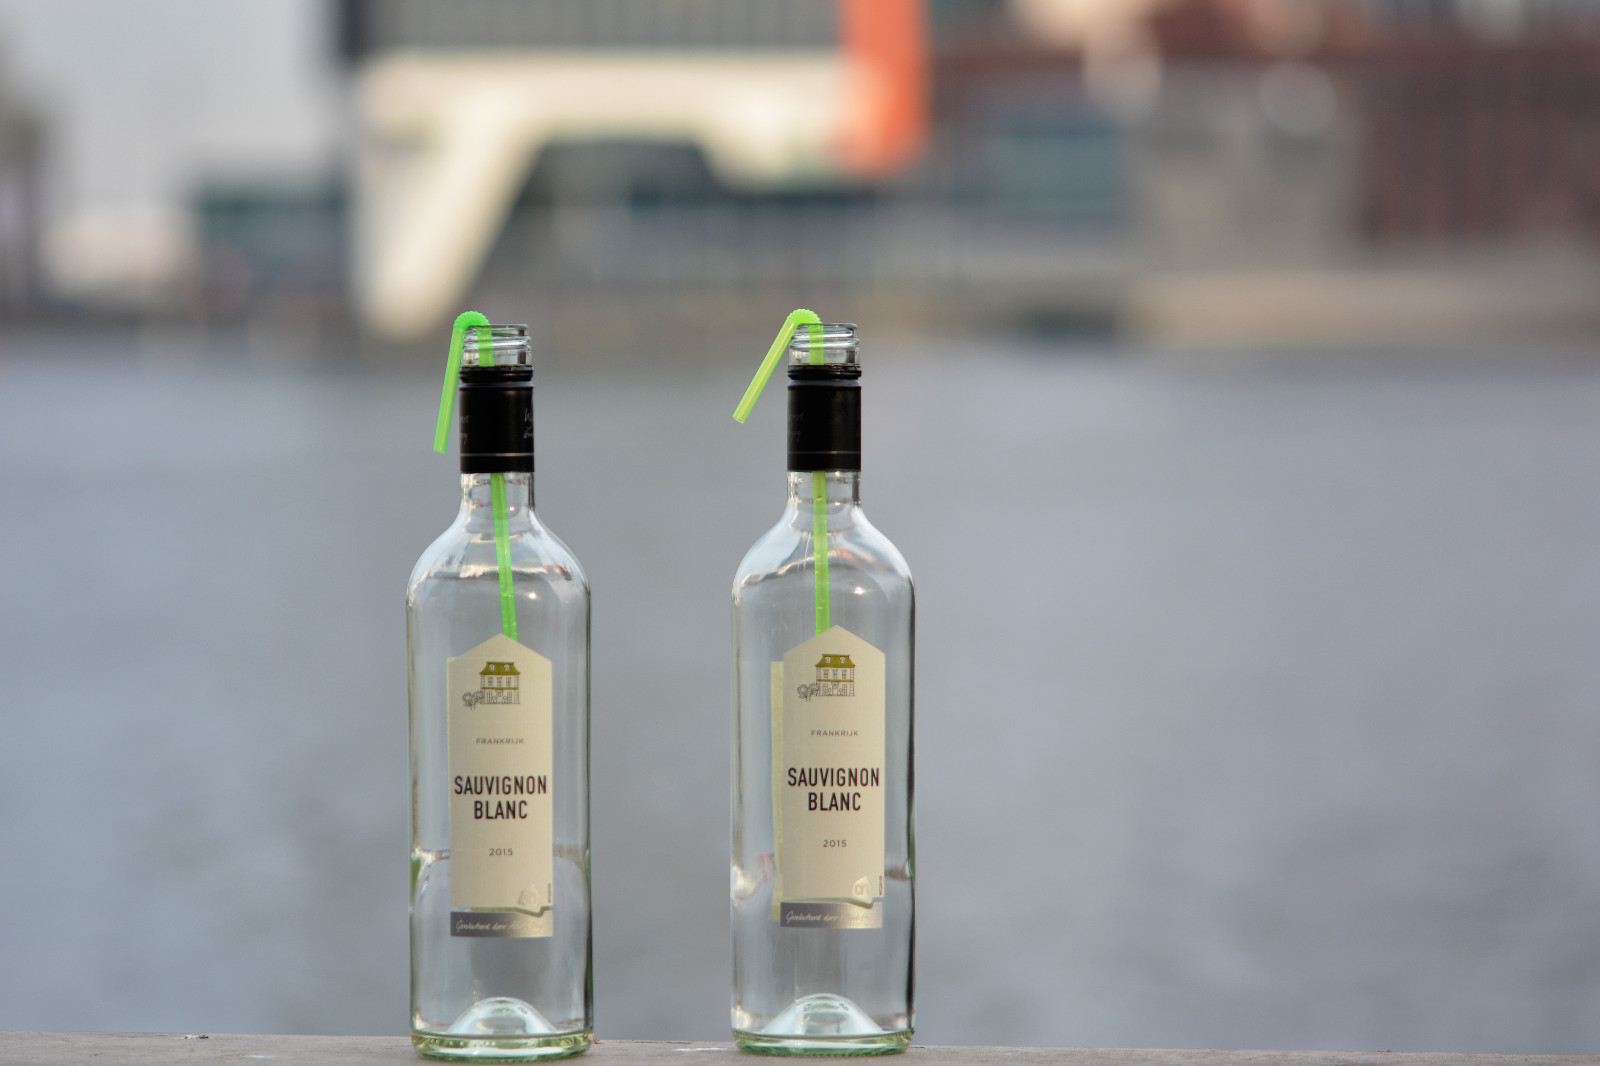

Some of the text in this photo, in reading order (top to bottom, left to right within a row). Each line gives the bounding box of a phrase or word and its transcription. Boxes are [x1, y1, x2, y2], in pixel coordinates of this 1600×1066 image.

[810, 729, 859, 737] FRANKRIJK
[454, 775, 547, 795] SAUVIGNON
[787, 767, 880, 787] SAUVIGNON
[474, 800, 528, 820] BLANC
[808, 792, 861, 811] BLANC
[489, 848, 513, 857] 2015
[823, 839, 847, 848] 2015
